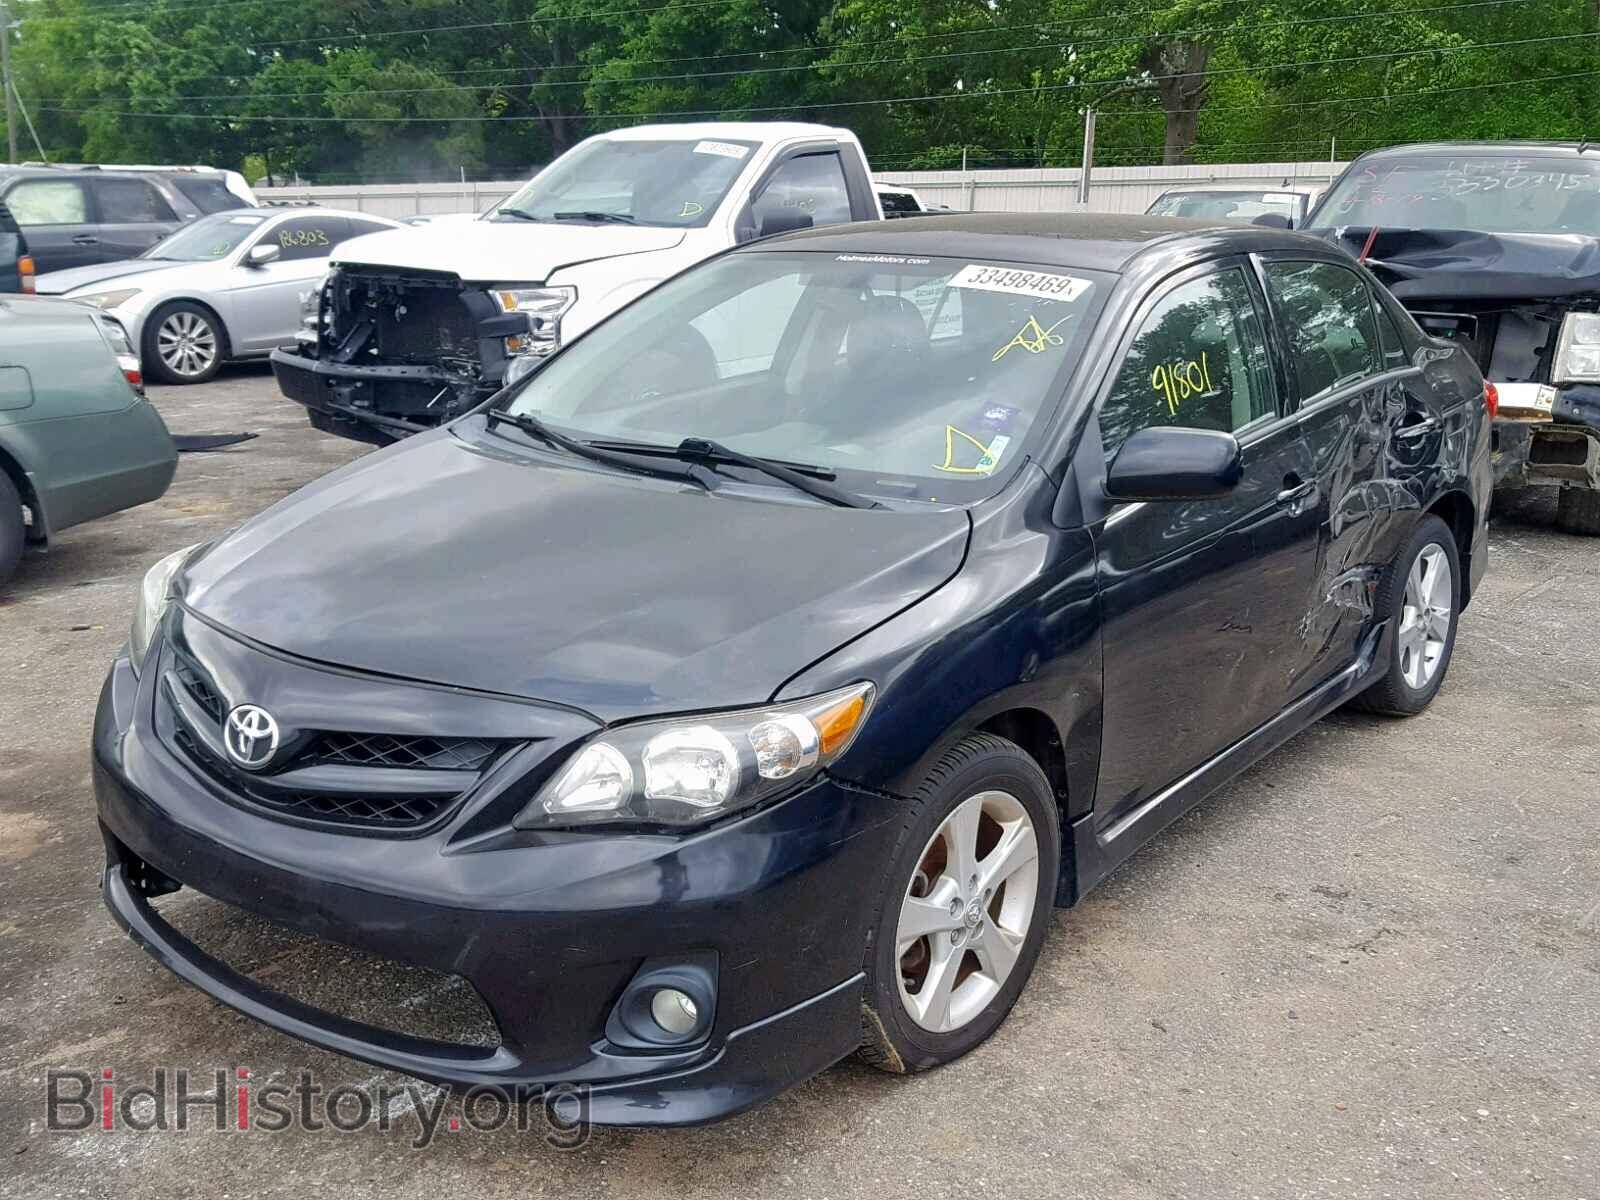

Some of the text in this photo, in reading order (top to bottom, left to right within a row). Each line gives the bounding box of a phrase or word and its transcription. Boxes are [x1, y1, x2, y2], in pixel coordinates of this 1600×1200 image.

[680, 201, 704, 217] D
[967, 268, 1073, 294] 33498469
[1152, 351, 1221, 416] 91801
